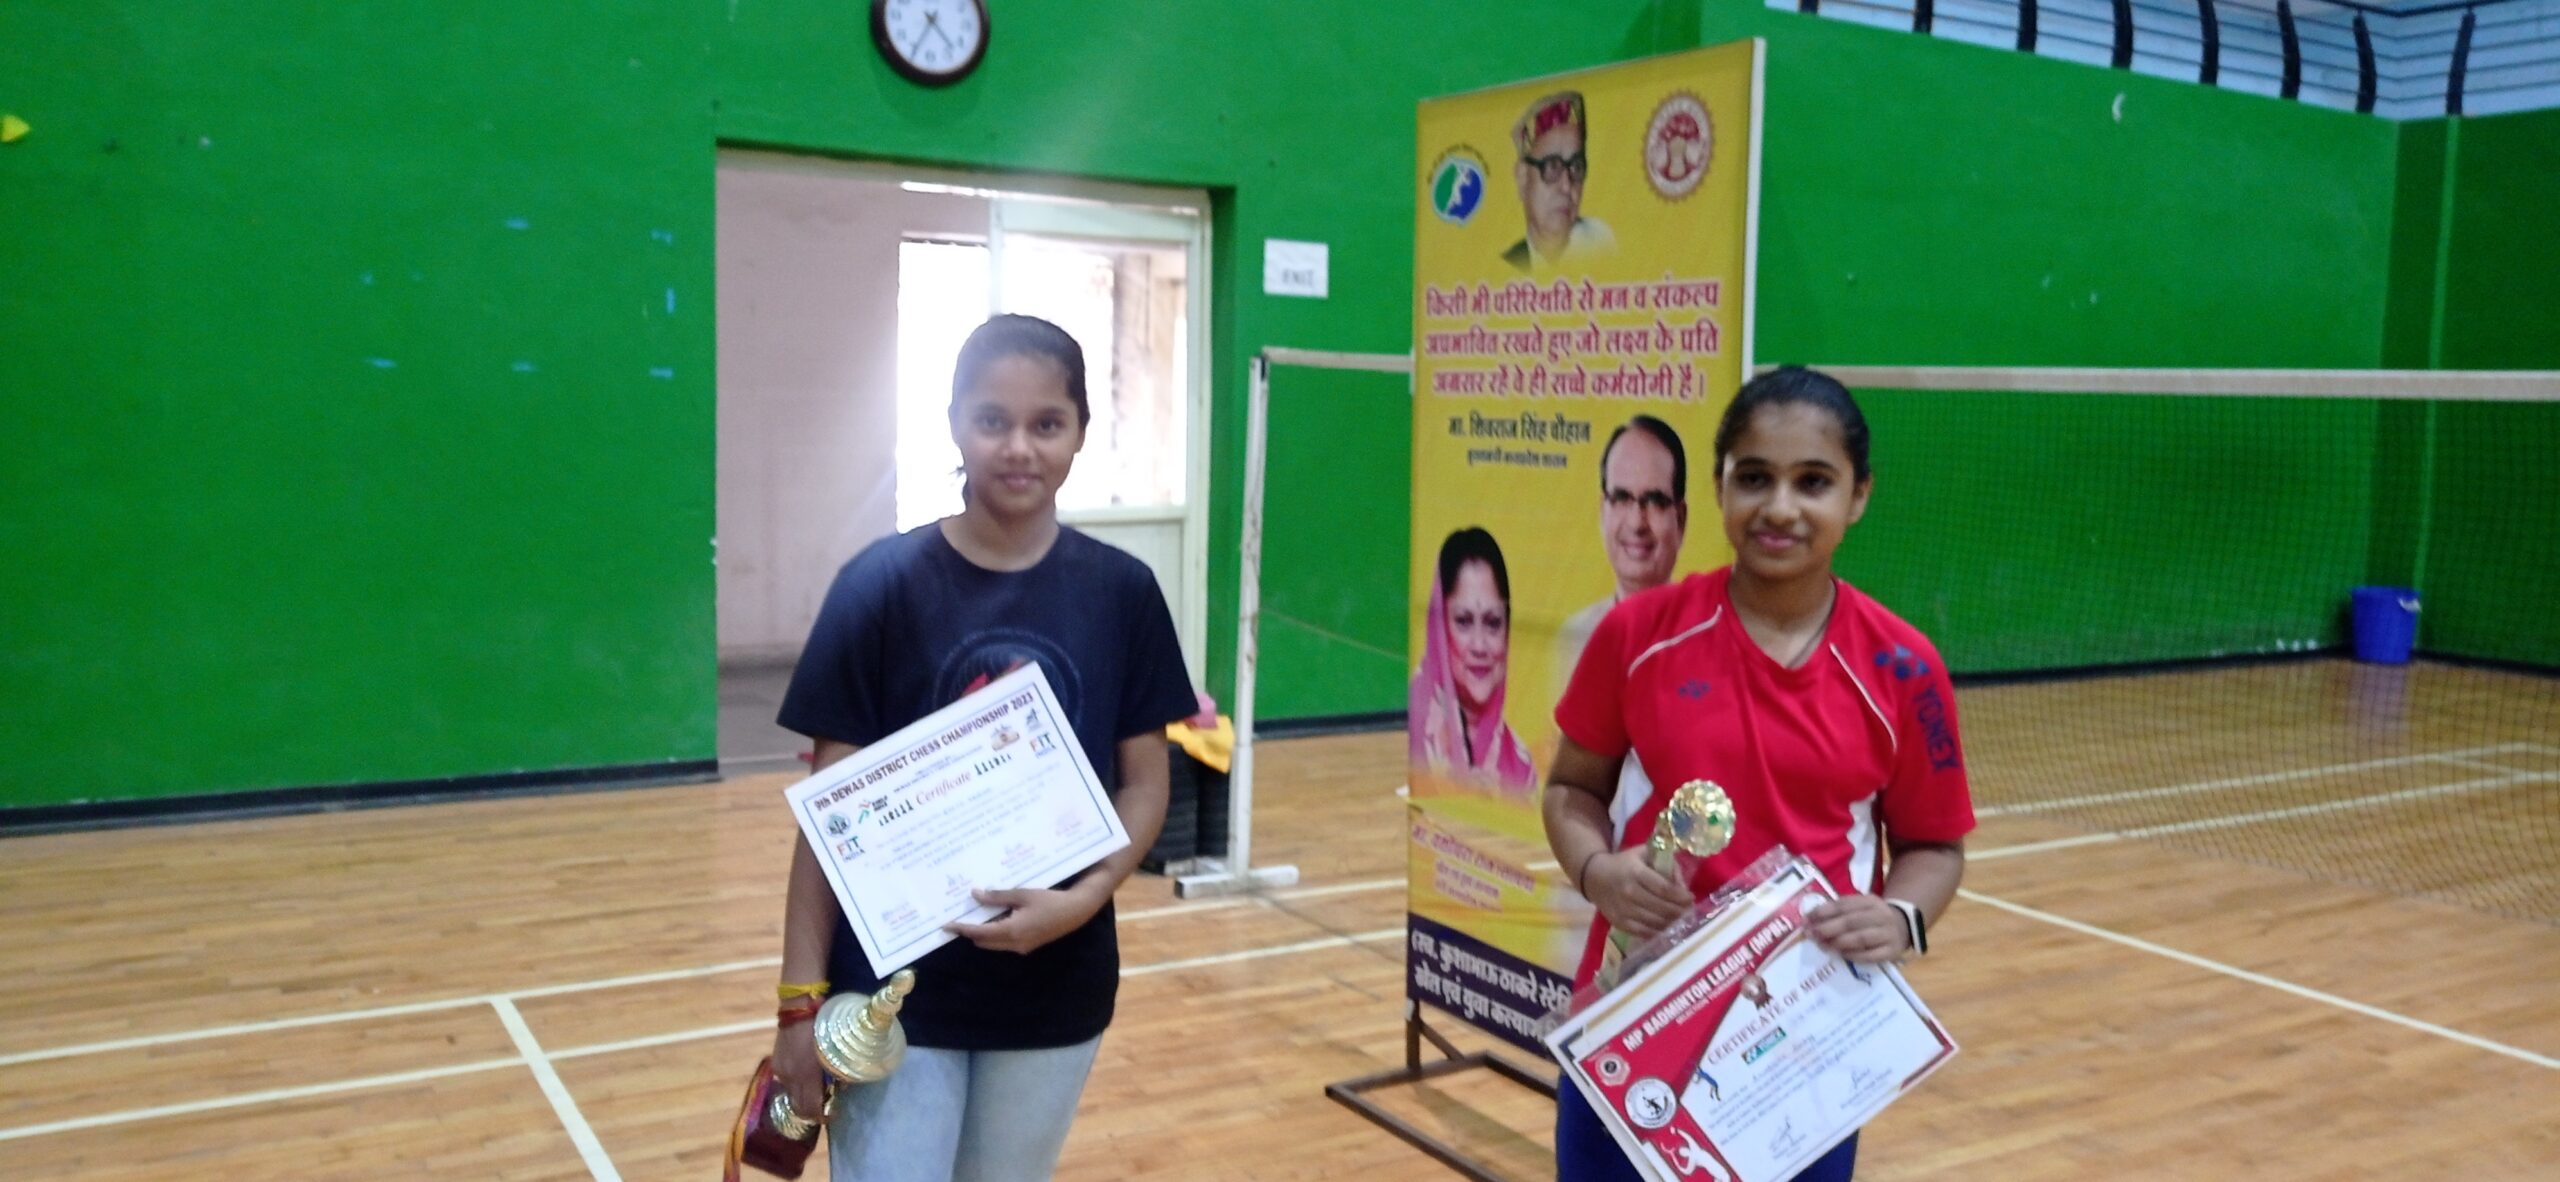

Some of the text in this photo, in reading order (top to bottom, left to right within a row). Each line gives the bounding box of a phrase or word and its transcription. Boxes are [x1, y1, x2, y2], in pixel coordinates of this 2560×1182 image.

[1426, 284, 1467, 316] किसी
[1472, 283, 1489, 315] भी
[1578, 278, 1594, 312] से
[1600, 285, 1628, 310] मन
[1633, 285, 1648, 309] व
[1653, 274, 1719, 309] संकल्प
[1502, 322, 1543, 354] रखते
[1548, 330, 1572, 362] हुए
[1575, 320, 1600, 353] जो
[1605, 329, 1649, 354] लक्ष्य
[1655, 319, 1675, 352] के
[1680, 316, 1719, 353] प्रति
[1529, 362, 1547, 397] ही
[1592, 362, 1674, 397] कर्मयोगी
[814, 797, 831, 811] 9th
[830, 778, 865, 802] DEWAS
[865, 755, 908, 785] DISTRICT
[909, 739, 941, 762] CHESS
[941, 704, 1009, 745] CHAMPIONSHIP
[1029, 732, 1052, 752] FIT
[915, 772, 971, 805] Certificate
[836, 835, 859, 856] FIT
[1623, 1028, 1643, 1051] MP
[1645, 980, 1711, 1034] BADMINTON
[1710, 945, 1753, 986] LEAGUE
[1752, 915, 1793, 954] (MPBL)
[1706, 1005, 1782, 1065] CERTIFICATE
[1783, 990, 1799, 1006] OF
